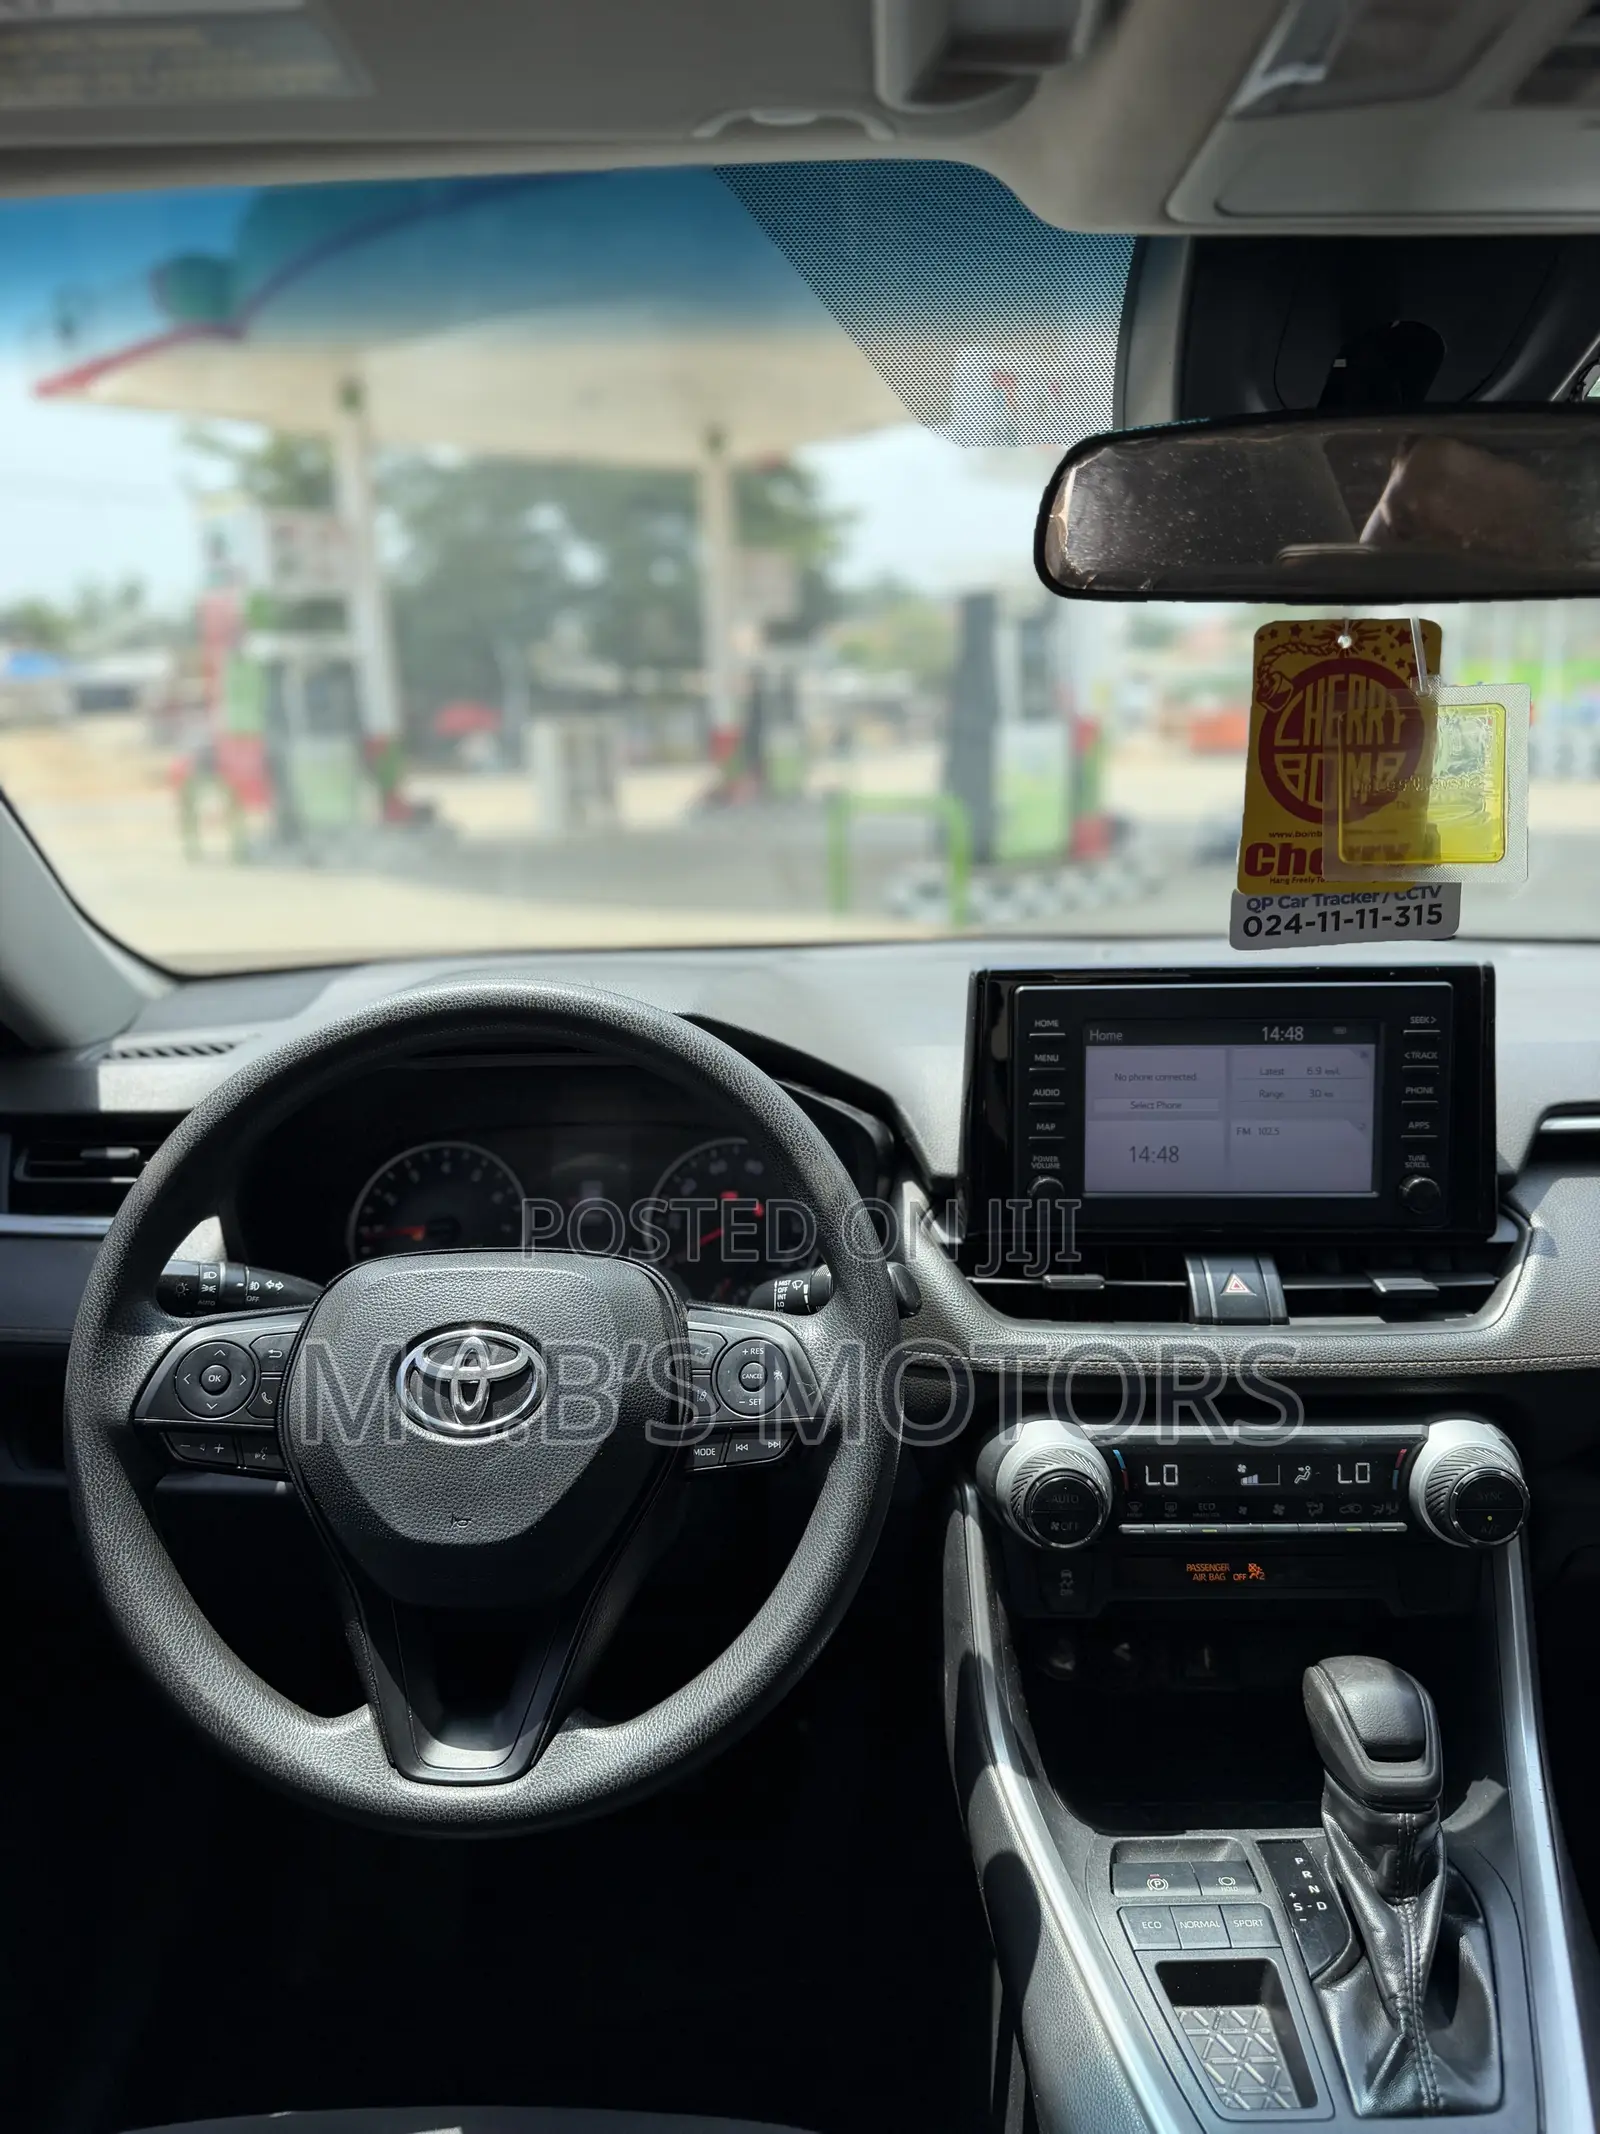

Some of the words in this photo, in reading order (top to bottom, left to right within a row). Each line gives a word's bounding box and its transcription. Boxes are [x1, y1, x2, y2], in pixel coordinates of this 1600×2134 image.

[1273, 674, 1407, 747] CHERRY
[1291, 875, 1315, 886] Freely
[1246, 897, 1274, 913] QP
[1277, 894, 1309, 910] Car
[1313, 889, 1380, 908] Tracker
[1394, 885, 1442, 902] CCTV
[1242, 903, 1443, 938] 024-11-11-315
[1034, 1019, 1060, 1028] HOME
[1089, 1029, 1124, 1042] Home
[1261, 1026, 1304, 1041] 14:48
[1034, 1053, 1060, 1063] MENU
[1259, 1066, 1285, 1076] Latest
[1114, 1072, 1127, 1082] No
[1128, 1072, 1154, 1084] phone
[1154, 1072, 1198, 1082] connected
[1032, 1088, 1061, 1097] AUDIO
[1258, 1089, 1285, 1100] Range
[1405, 1086, 1434, 1095] PHONE
[1130, 1100, 1155, 1110] Select
[1156, 1100, 1182, 1110] Phone
[1036, 1122, 1056, 1131] MAP
[1408, 1121, 1430, 1130] APPS
[1235, 1126, 1251, 1136] FM
[1128, 1145, 1180, 1164] 14:48
[777, 1286, 789, 1294] OFF
[245, 1295, 260, 1303] OFF
[750, 1347, 765, 1355] RES
[208, 1374, 222, 1383] OK
[748, 1398, 762, 1406] SET
[693, 1448, 716, 1456] MODE
[1144, 1463, 1179, 1486] LO
[1337, 1462, 1371, 1484] LO
[1197, 1502, 1216, 1511] ECO
[1186, 1562, 1231, 1572] PASSENGER
[1192, 1572, 1207, 1582] AIR
[1208, 1572, 1227, 1581] BAG
[1232, 1573, 1247, 1581] OFF
[1294, 1857, 1304, 1865] P
[1301, 1870, 1313, 1879] R
[1308, 1884, 1321, 1894] N
[1292, 1902, 1303, 1912] S
[1316, 1901, 1328, 1911] D
[1141, 1921, 1162, 1929] ECO
[1179, 1920, 1221, 1929] NORMAL
[1233, 1919, 1263, 1928] SPORT
